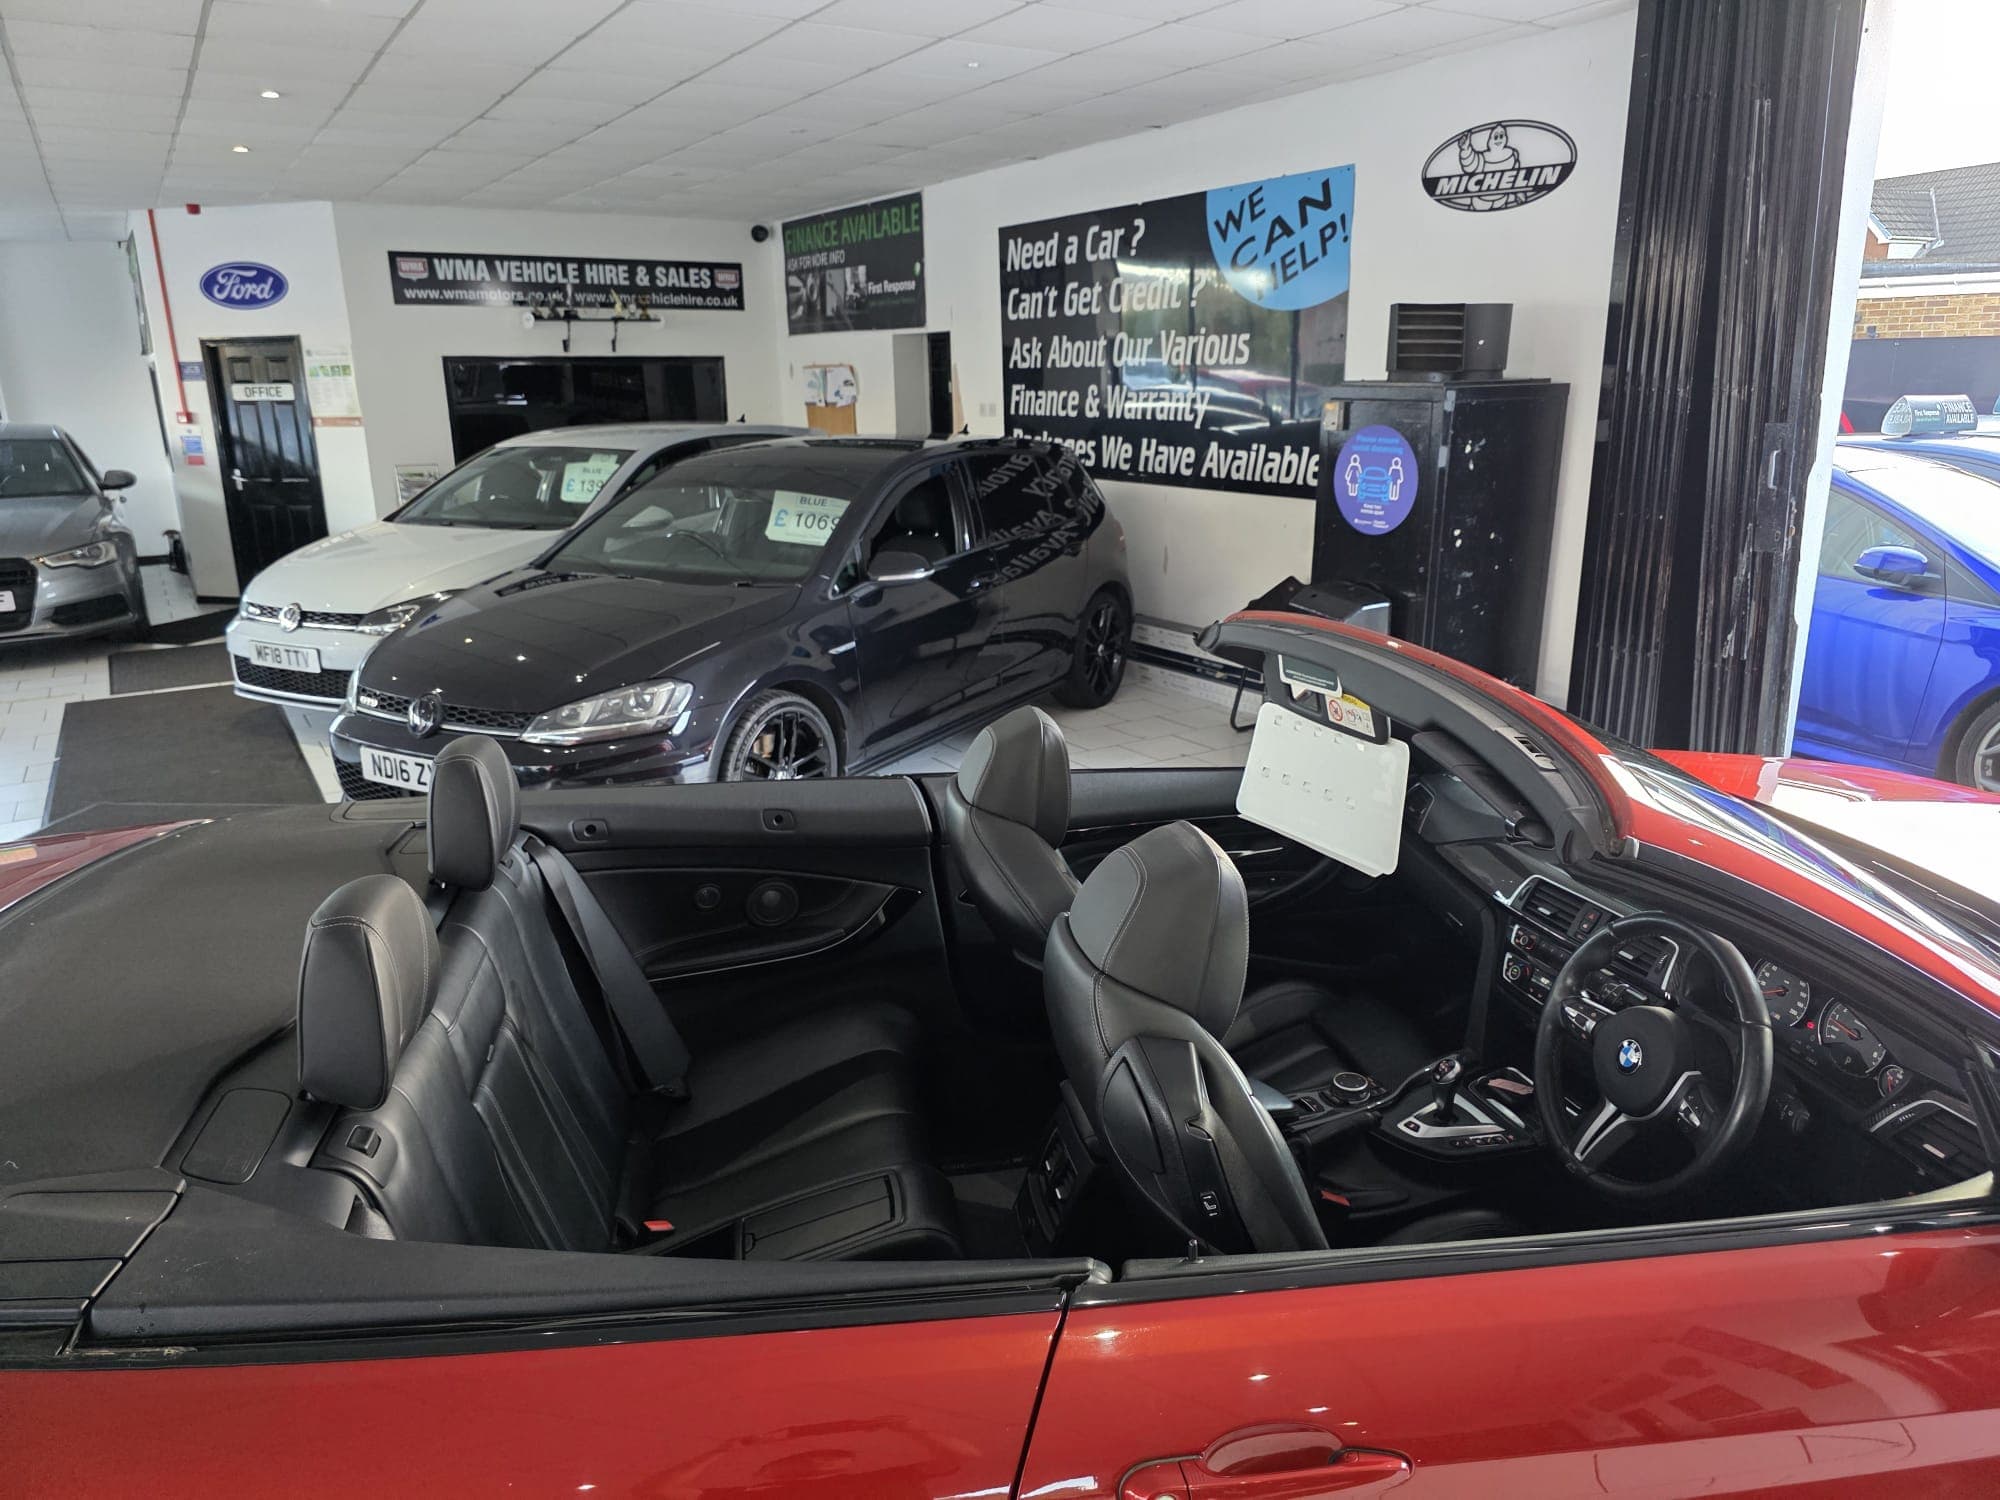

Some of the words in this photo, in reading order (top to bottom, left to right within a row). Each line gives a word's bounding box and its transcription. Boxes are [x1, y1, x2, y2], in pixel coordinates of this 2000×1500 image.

[1434, 164, 1563, 196] MICHELIN
[785, 220, 839, 253] FINANCE
[841, 203, 920, 244] AVAILABLE
[1213, 185, 1266, 243] WE
[1230, 177, 1332, 272] CAN
[829, 248, 846, 264] INFO
[1006, 232, 1059, 272] Need
[1064, 235, 1079, 265] a
[1085, 225, 1125, 262] Car
[213, 268, 275, 300] Ford
[433, 257, 491, 282] WMA
[495, 259, 580, 285] VEHICLE
[585, 263, 630, 286] HIRE
[635, 265, 651, 287] &
[655, 266, 712, 289] SALES
[868, 281, 883, 295] First
[884, 280, 916, 295] Response
[1007, 286, 1058, 320] Can't
[1063, 281, 1102, 317] Get
[1109, 276, 1182, 313] Credit
[1009, 336, 1042, 369] Ask
[1047, 333, 1107, 369] About
[1112, 331, 1153, 368] Our
[1160, 327, 1251, 367] Various
[244, 386, 283, 399] OFFICE
[1010, 384, 1079, 417] Finance
[1085, 384, 1100, 418] &
[1106, 384, 1211, 429] Warranty
[1101, 435, 1133, 470] We
[1138, 437, 1196, 476] Have
[1200, 441, 1320, 487] Available
[799, 496, 828, 507] BLUE
[371, 753, 410, 782] ND16
